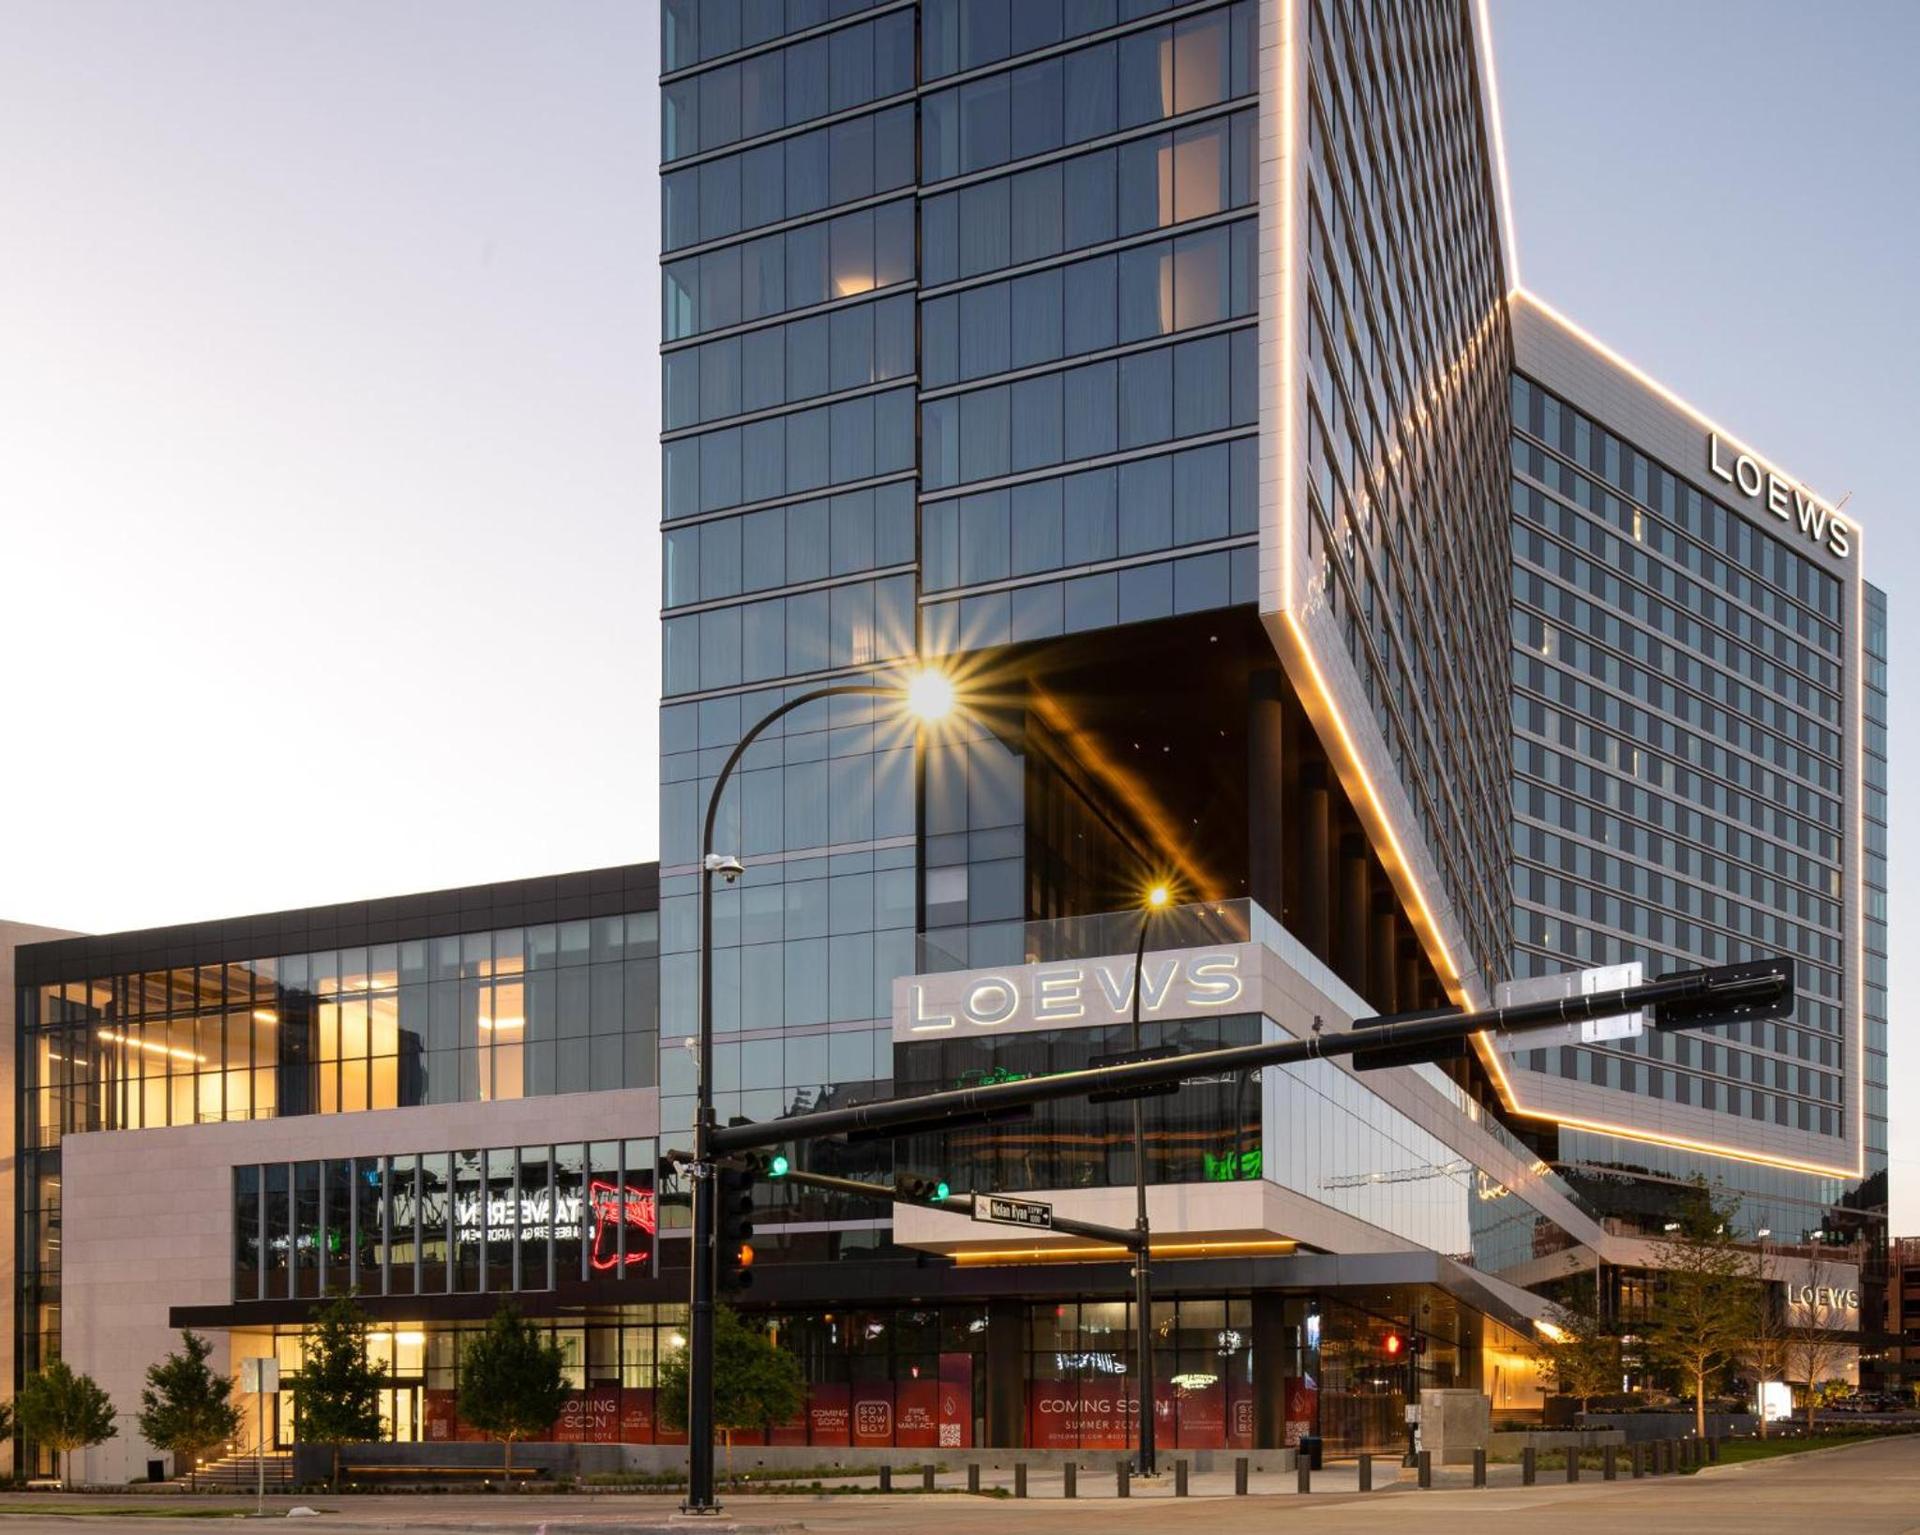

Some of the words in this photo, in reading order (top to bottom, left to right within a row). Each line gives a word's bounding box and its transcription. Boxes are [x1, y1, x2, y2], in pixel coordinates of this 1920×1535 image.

[1708, 432, 1850, 558] LOEWS
[908, 953, 1243, 1032] LOEWS
[992, 1201, 1011, 1218] Nolan
[1011, 1204, 1028, 1223] Ryan
[1787, 1283, 1859, 1310] LOEWS
[859, 1406, 885, 1416] SOY
[1040, 1399, 1111, 1413] COMING
[1116, 1399, 1168, 1413] SON
[811, 1409, 849, 1418] COMING
[817, 1418, 845, 1427] SOON
[860, 1415, 887, 1424] COW
[860, 1423, 885, 1433] BOY
[1065, 1420, 1110, 1430] SUMMER
